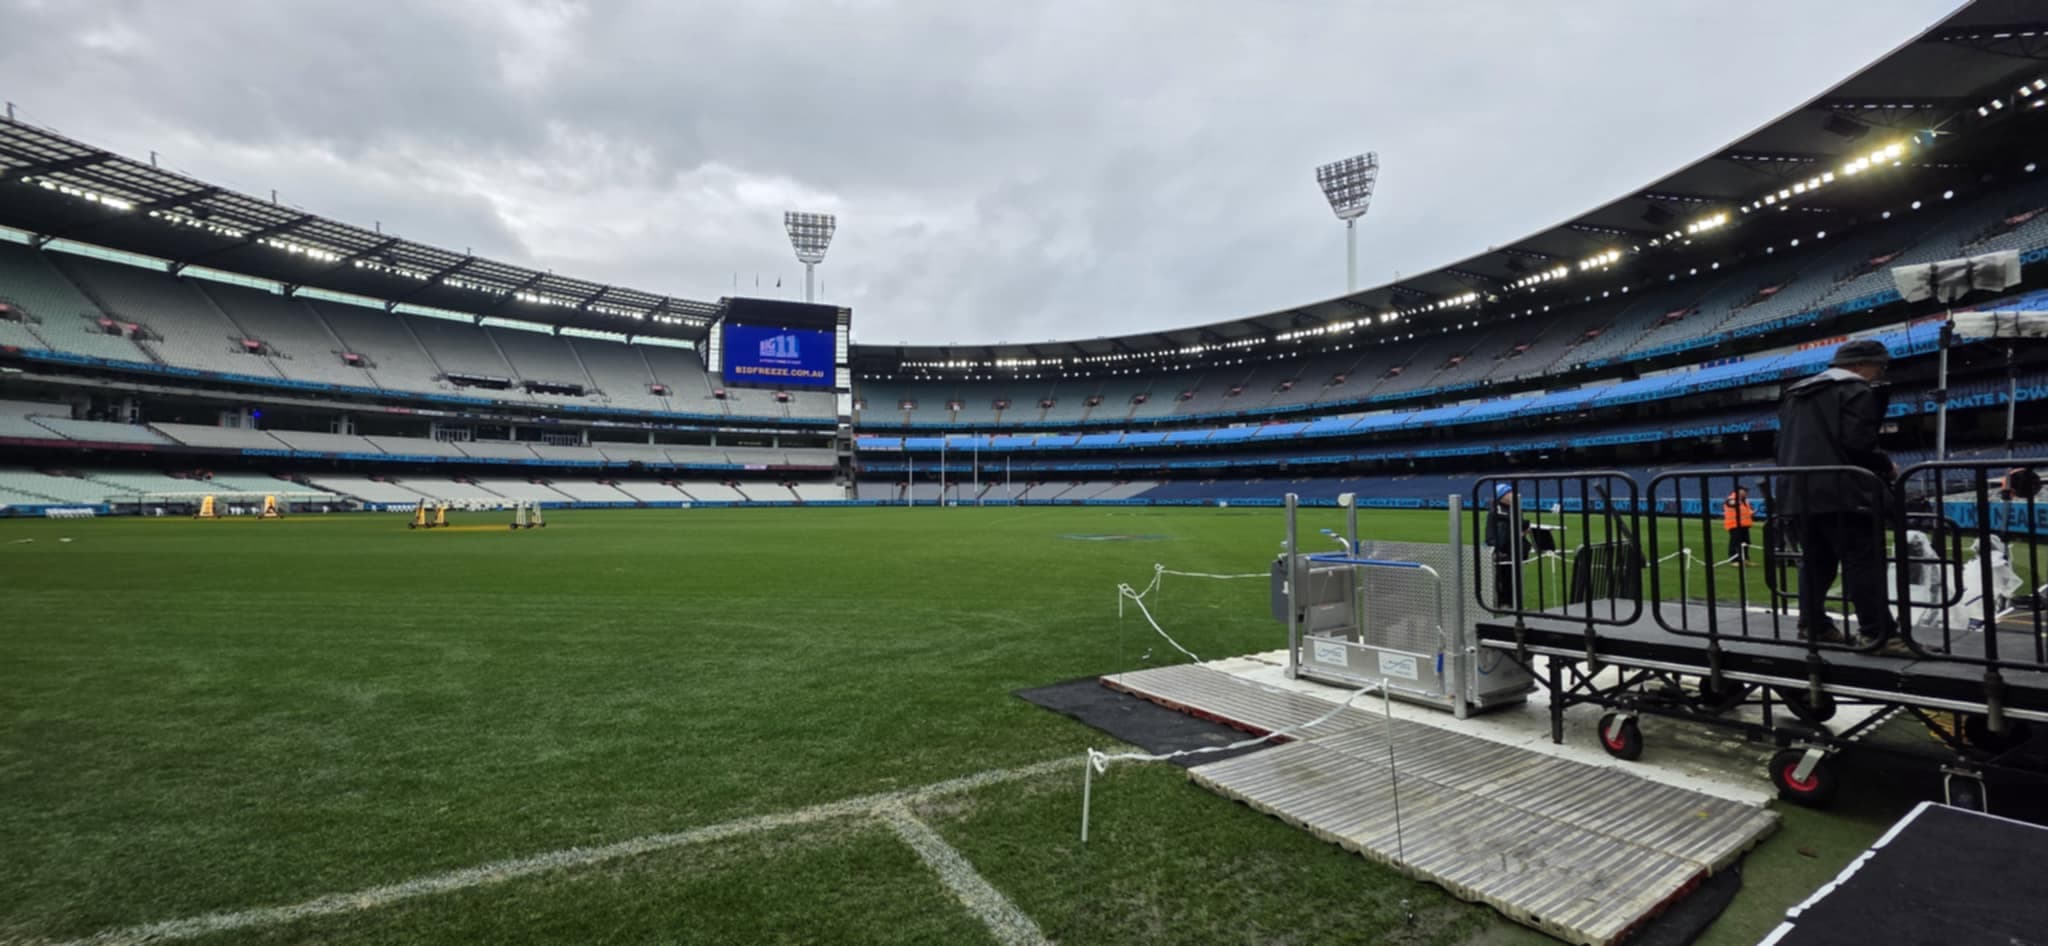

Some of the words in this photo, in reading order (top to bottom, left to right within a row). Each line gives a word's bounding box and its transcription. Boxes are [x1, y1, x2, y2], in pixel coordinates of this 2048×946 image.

[1733, 318, 1784, 338] DONATE
[1785, 311, 1819, 325] NOW
[776, 335, 799, 358] 11
[735, 366, 824, 378] BIGFREEZE.COM.AU
[1699, 377, 1746, 392] DONATE
[1748, 370, 1780, 384] NOW
[1923, 391, 1995, 412] DNATE
[1672, 424, 1719, 438] DONATE
[1721, 422, 1752, 432] NOW
